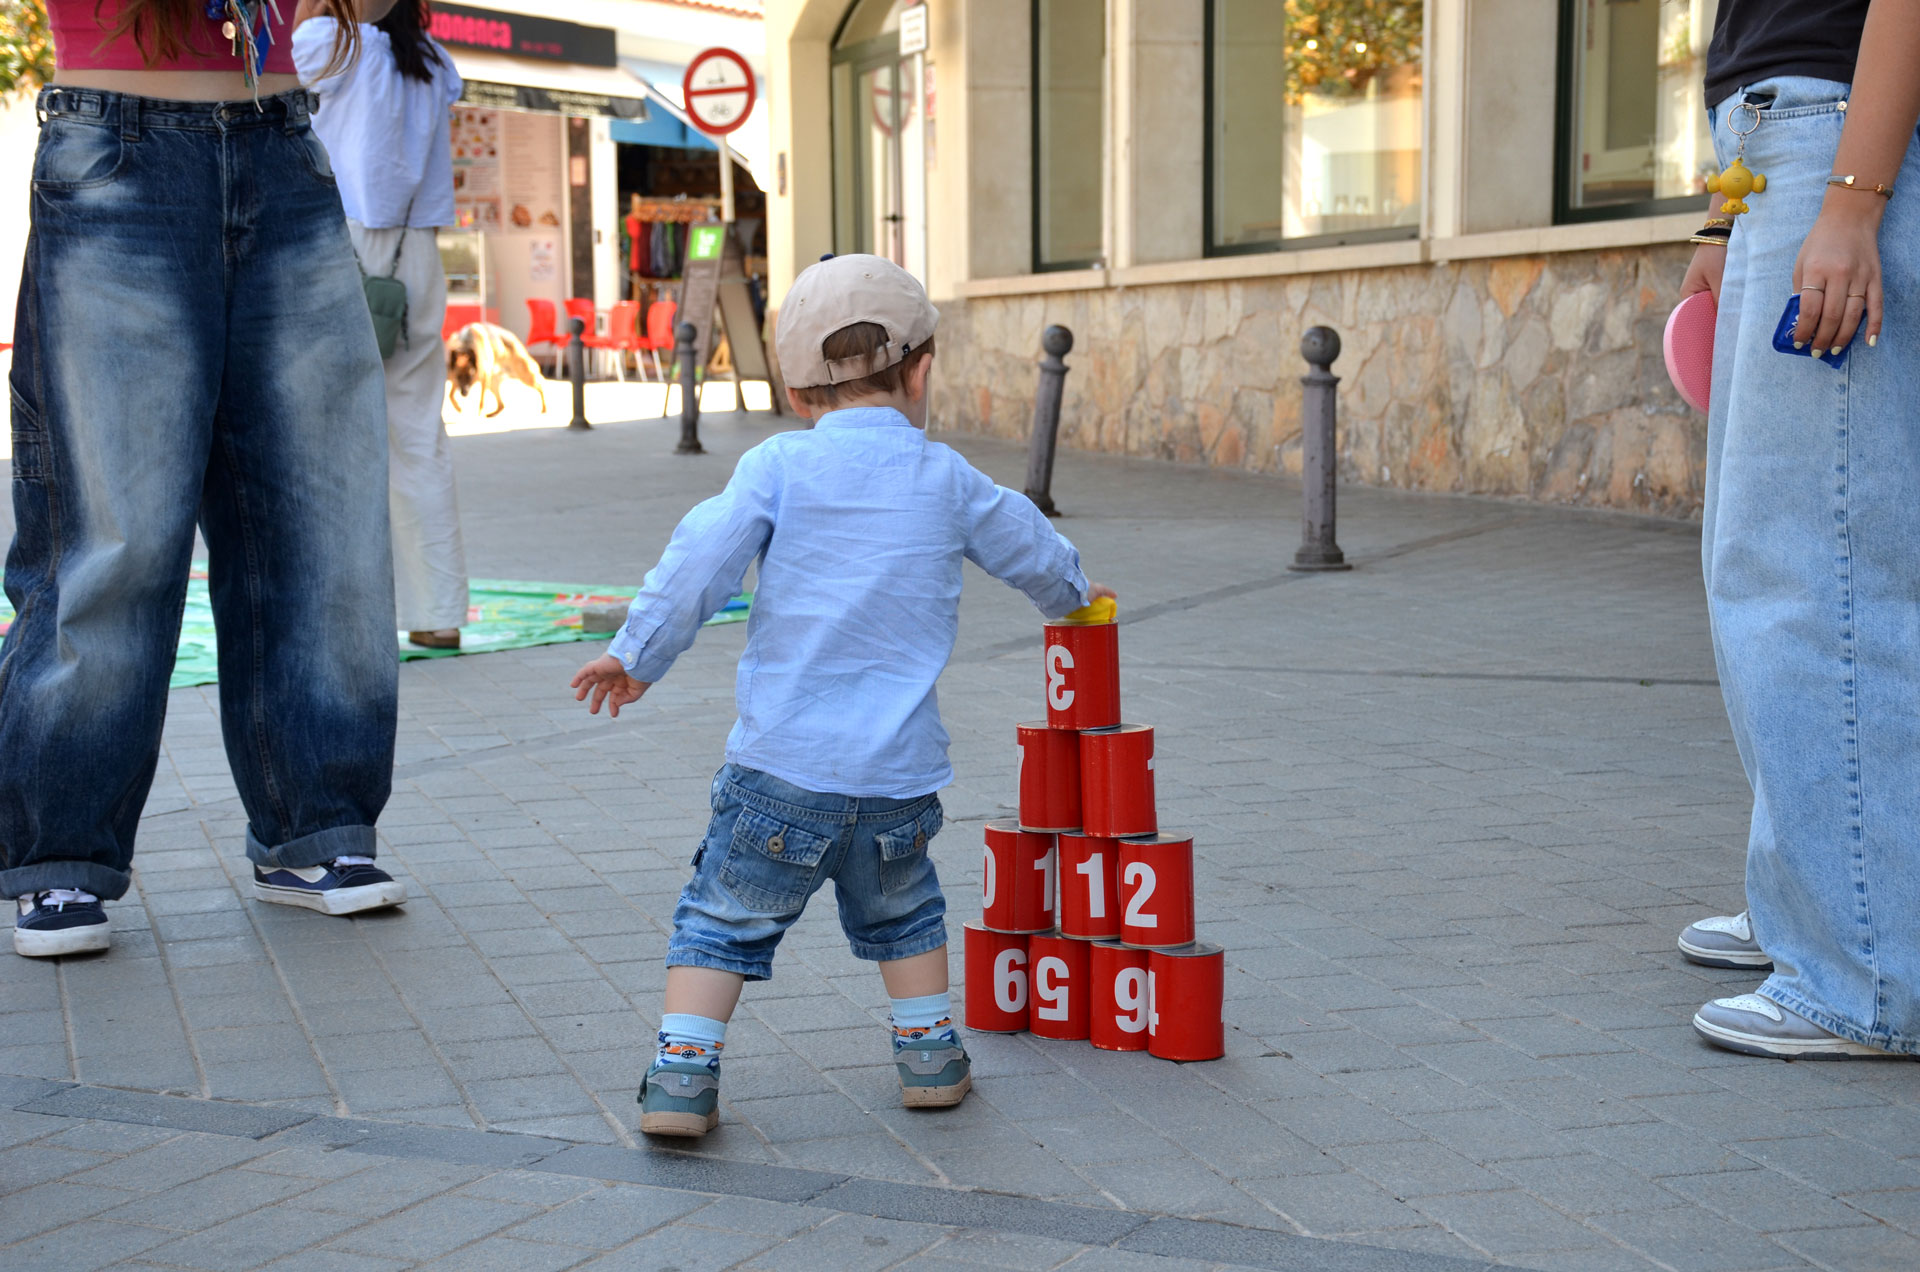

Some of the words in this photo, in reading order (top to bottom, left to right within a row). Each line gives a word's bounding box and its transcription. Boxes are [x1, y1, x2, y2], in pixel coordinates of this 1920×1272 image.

[1046, 644, 1075, 711] 3
[1076, 852, 1120, 918] 1
[1124, 861, 1158, 928] 2
[1036, 956, 1070, 1022] 5
